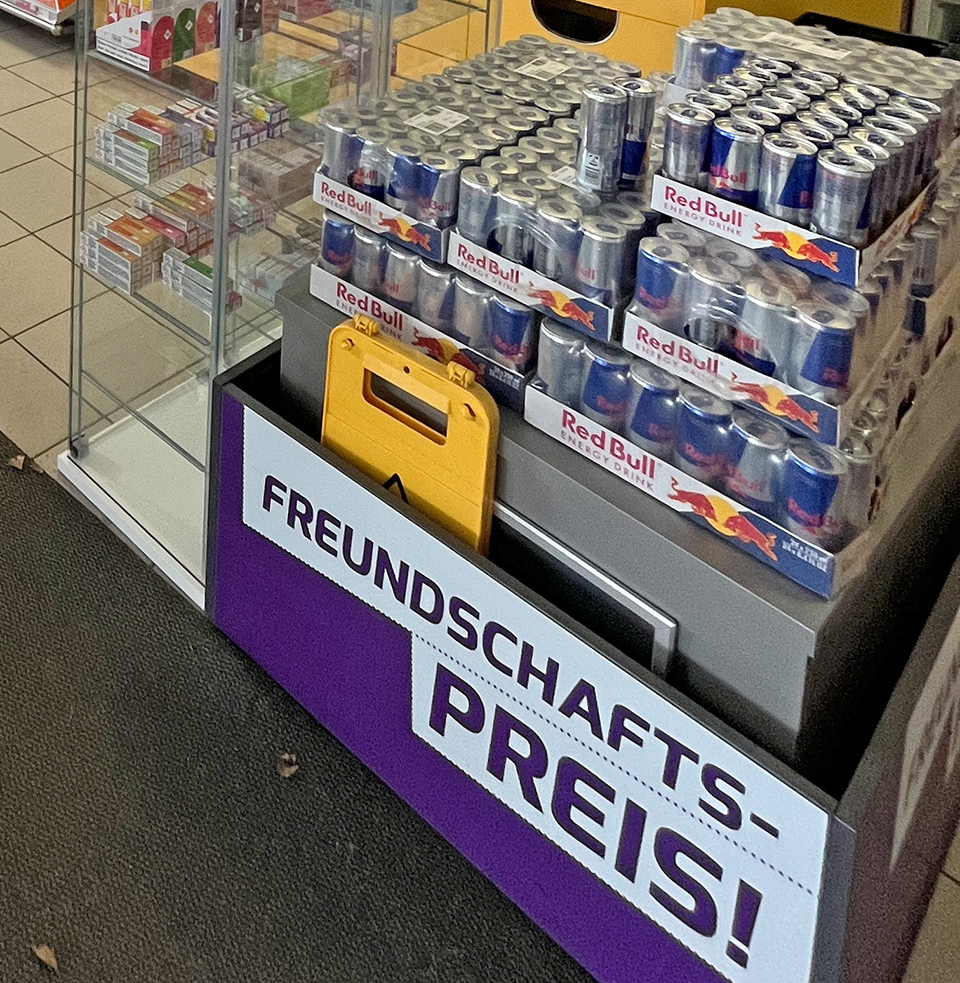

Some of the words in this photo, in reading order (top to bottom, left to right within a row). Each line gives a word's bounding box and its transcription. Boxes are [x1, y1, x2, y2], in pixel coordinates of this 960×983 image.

[321, 182, 345, 203] Red
[348, 194, 372, 215] Bull
[664, 185, 701, 214] Red
[704, 200, 742, 227] Bull
[664, 203, 704, 224] ENERGY
[709, 218, 742, 237] DRINK
[457, 244, 486, 269] Red
[488, 259, 520, 284] Bull
[337, 281, 368, 312] Red
[371, 300, 402, 331] Bull
[635, 343, 678, 367] ENERGY
[637, 326, 674, 356] Red
[679, 344, 718, 374] Bull
[560, 431, 609, 465] ENERGY
[614, 463, 654, 492] DRINK
[562, 409, 606, 450] Red
[610, 438, 656, 479] Bull
[261, 475, 780, 839] FREUNDSCHAFTS-
[430, 662, 765, 969] PREIS!
